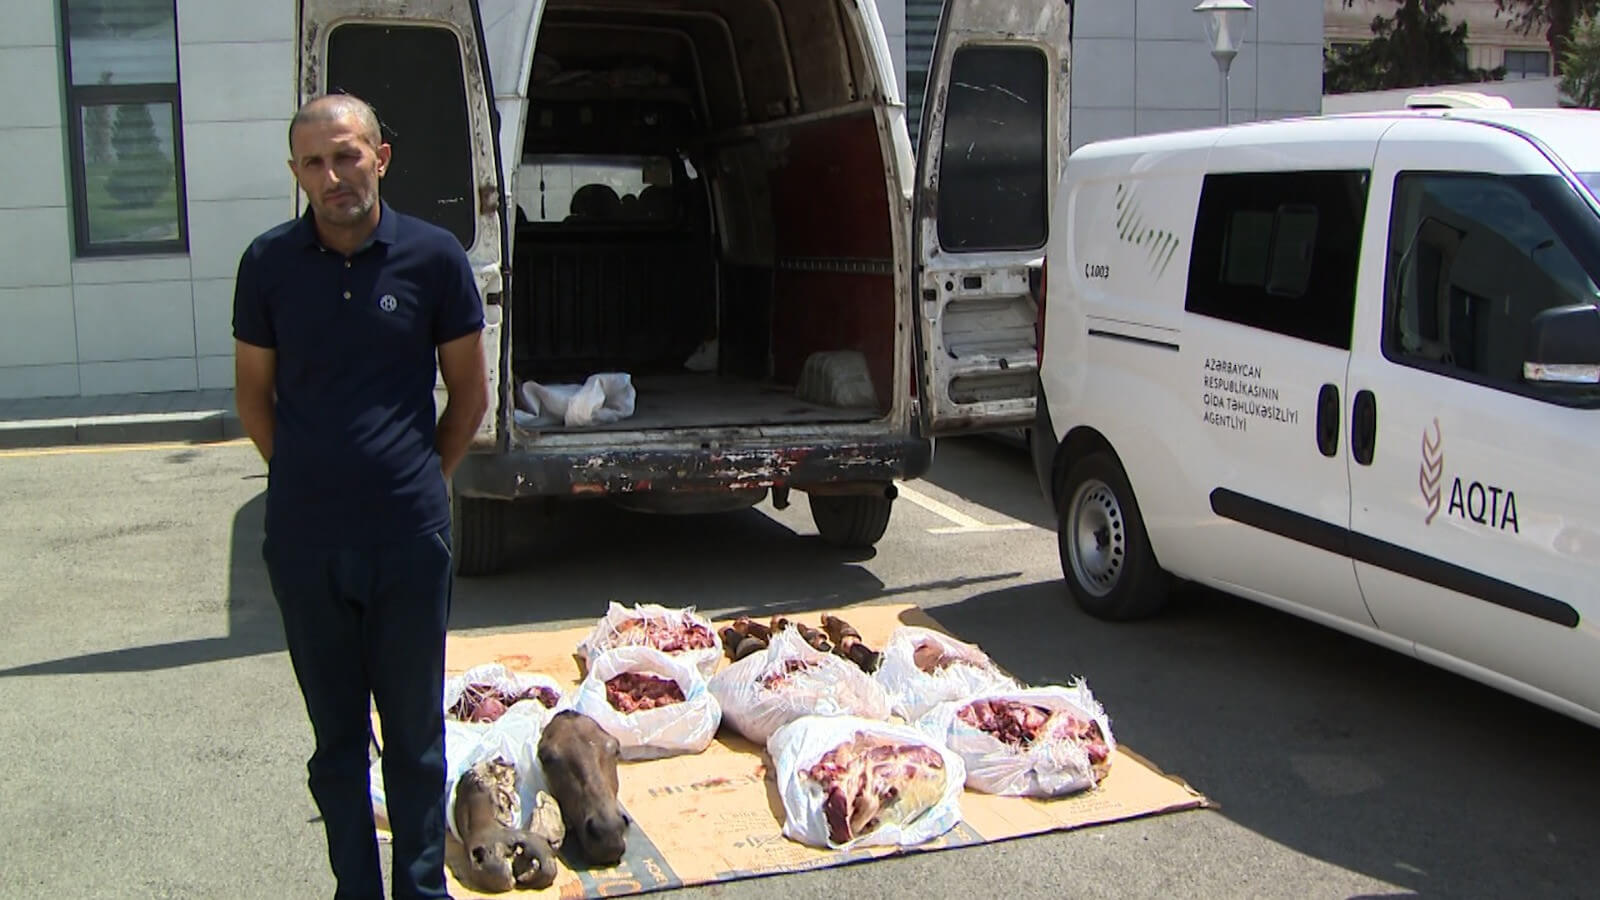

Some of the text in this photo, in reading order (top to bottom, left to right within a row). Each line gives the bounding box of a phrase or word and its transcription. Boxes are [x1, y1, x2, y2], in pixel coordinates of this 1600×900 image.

[1091, 265, 1109, 279] 1003
[1204, 358, 1262, 379] AZƏRBAYCAN
[1448, 477, 1519, 533] AQTA
